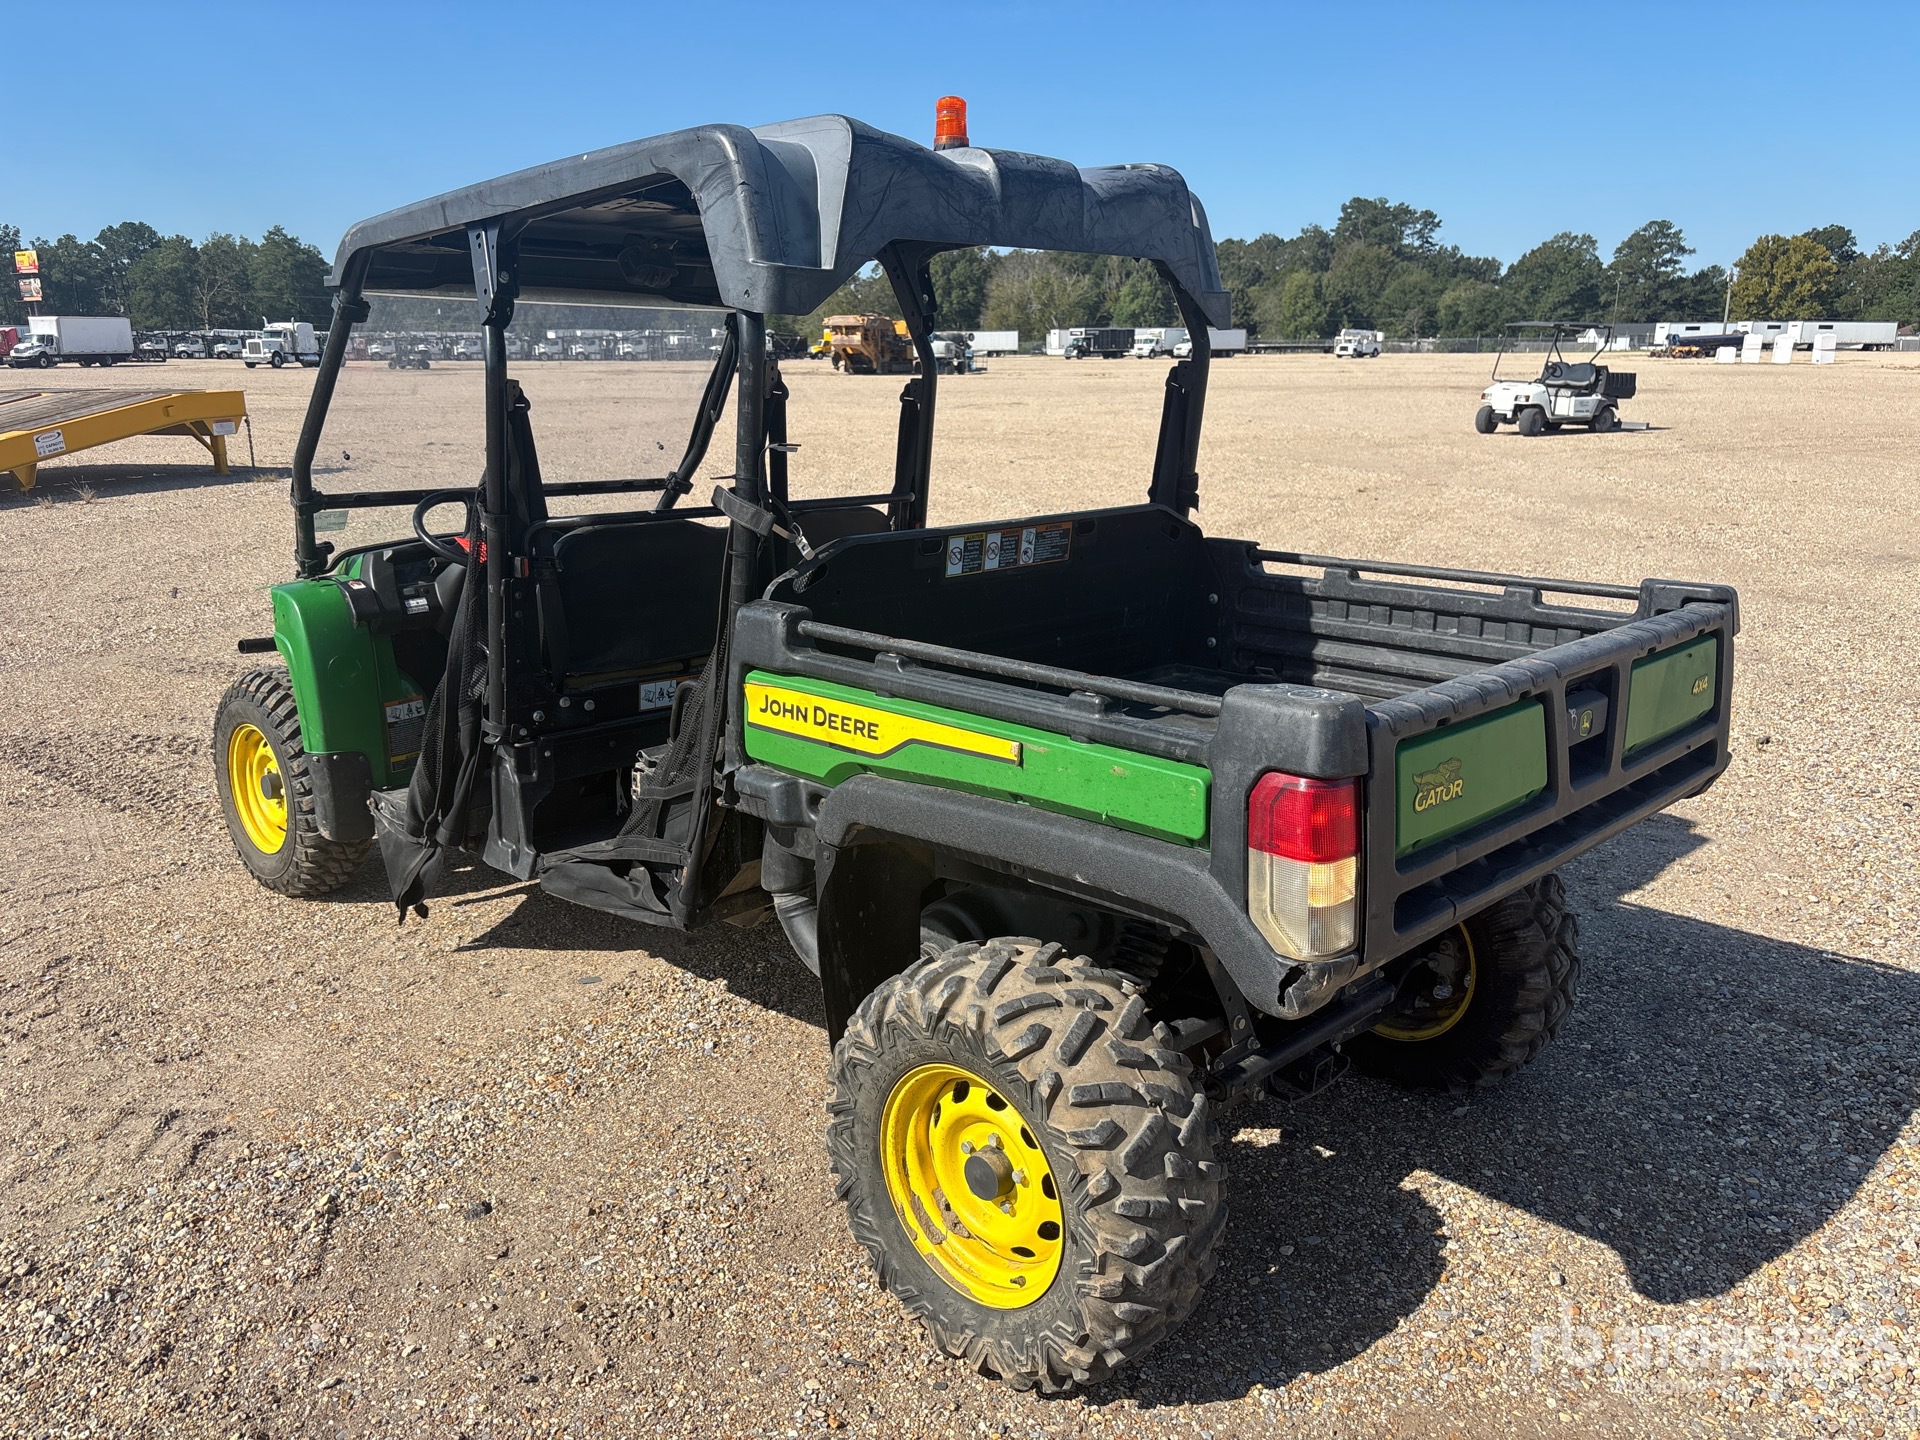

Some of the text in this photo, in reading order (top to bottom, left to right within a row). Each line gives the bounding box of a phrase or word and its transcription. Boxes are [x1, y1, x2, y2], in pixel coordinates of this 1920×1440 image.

[760, 694, 879, 740] JOHN DEERE
[1414, 779, 1464, 812] GATOR
